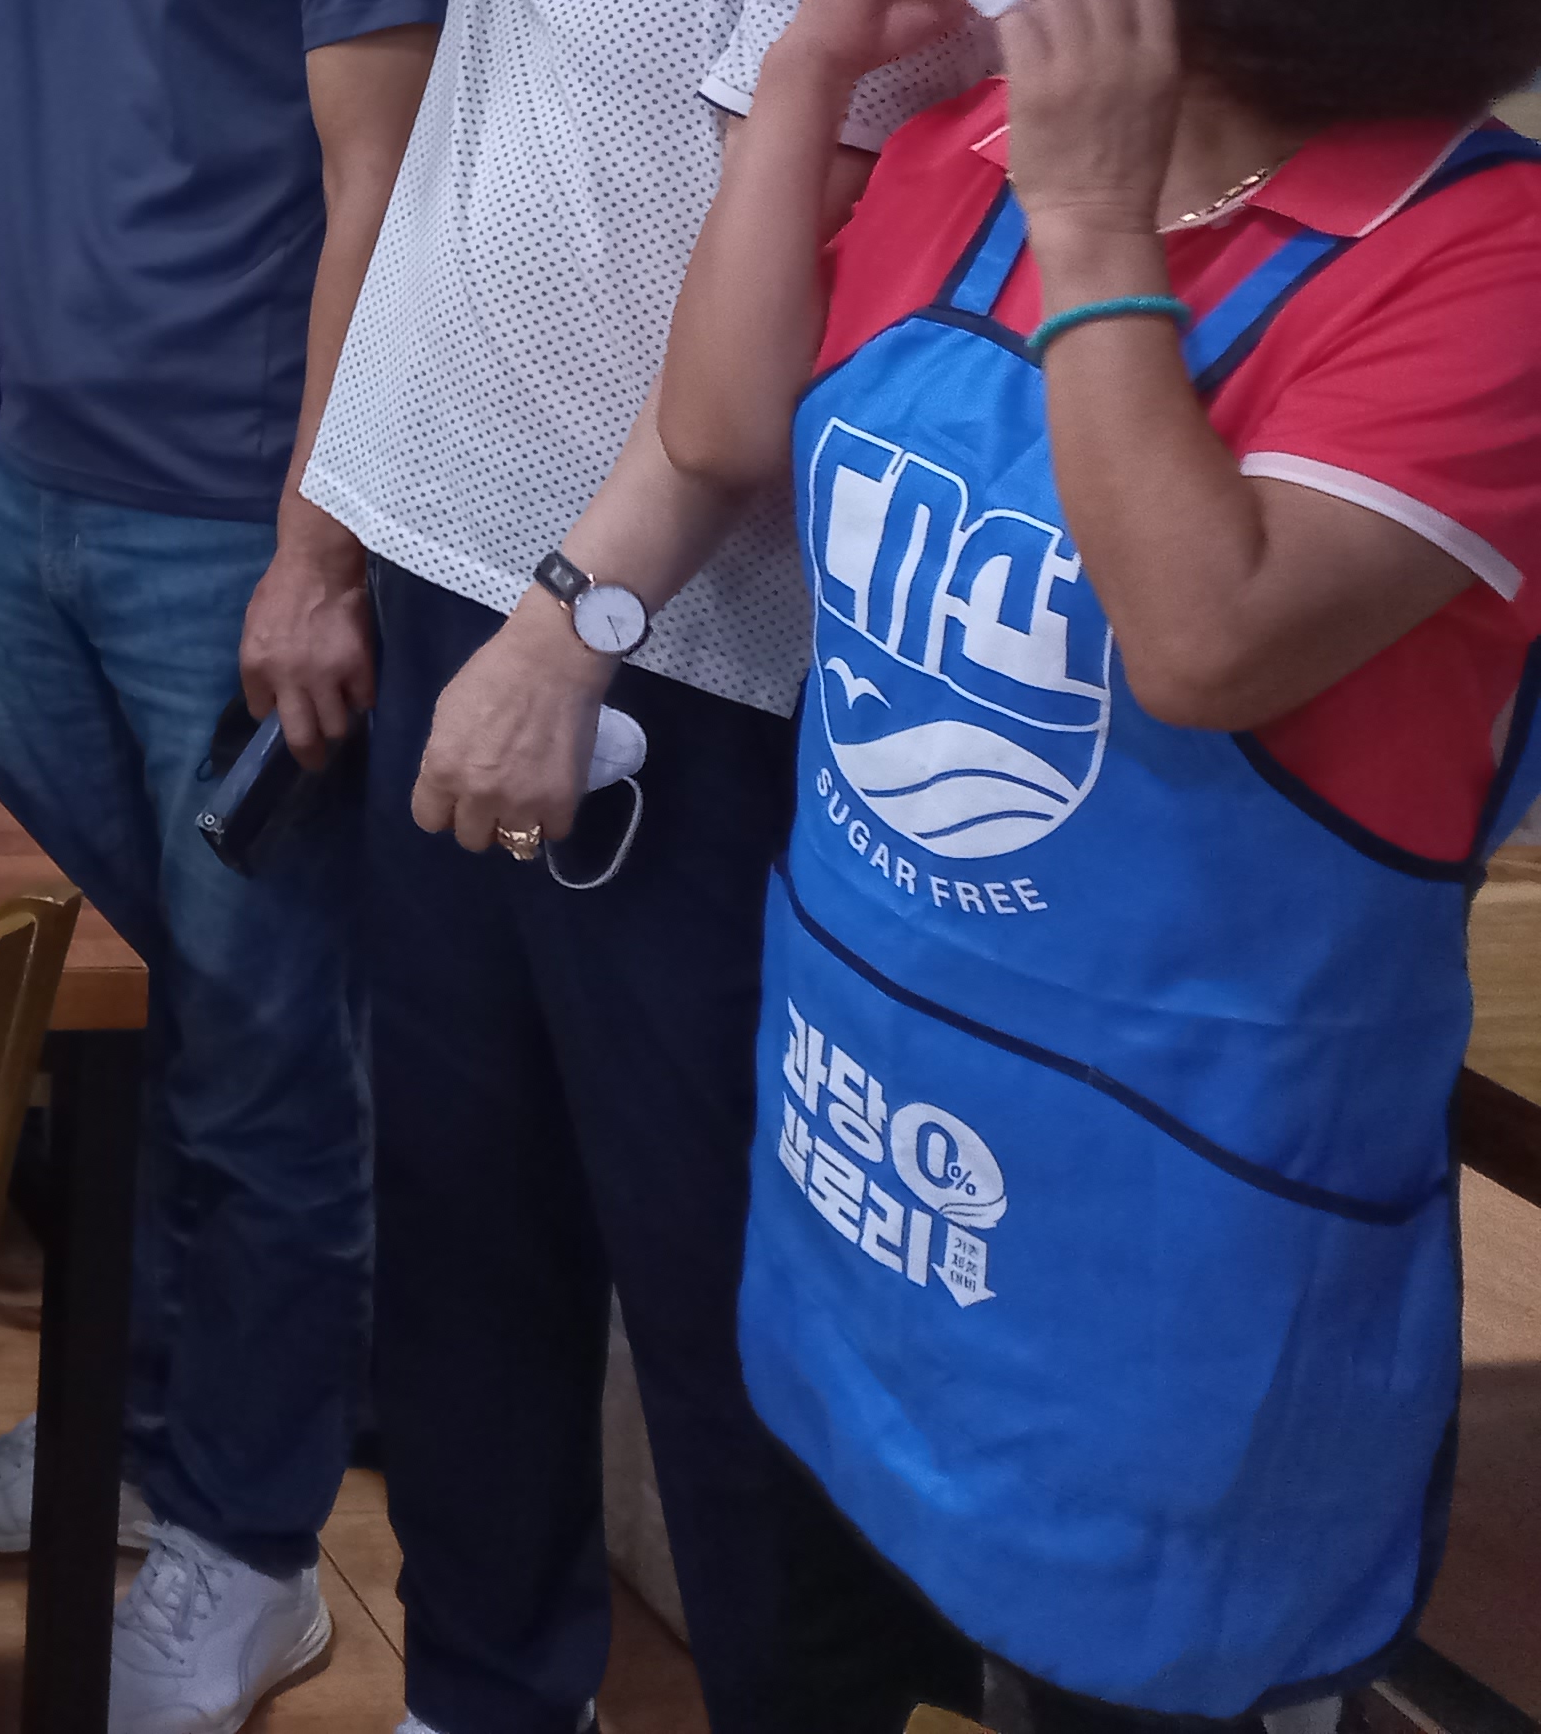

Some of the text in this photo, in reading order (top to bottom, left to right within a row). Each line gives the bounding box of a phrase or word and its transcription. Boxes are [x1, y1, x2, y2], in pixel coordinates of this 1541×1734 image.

[816, 767, 1049, 916] SUGAR FREE
[915, 1120, 978, 1197] 0%
